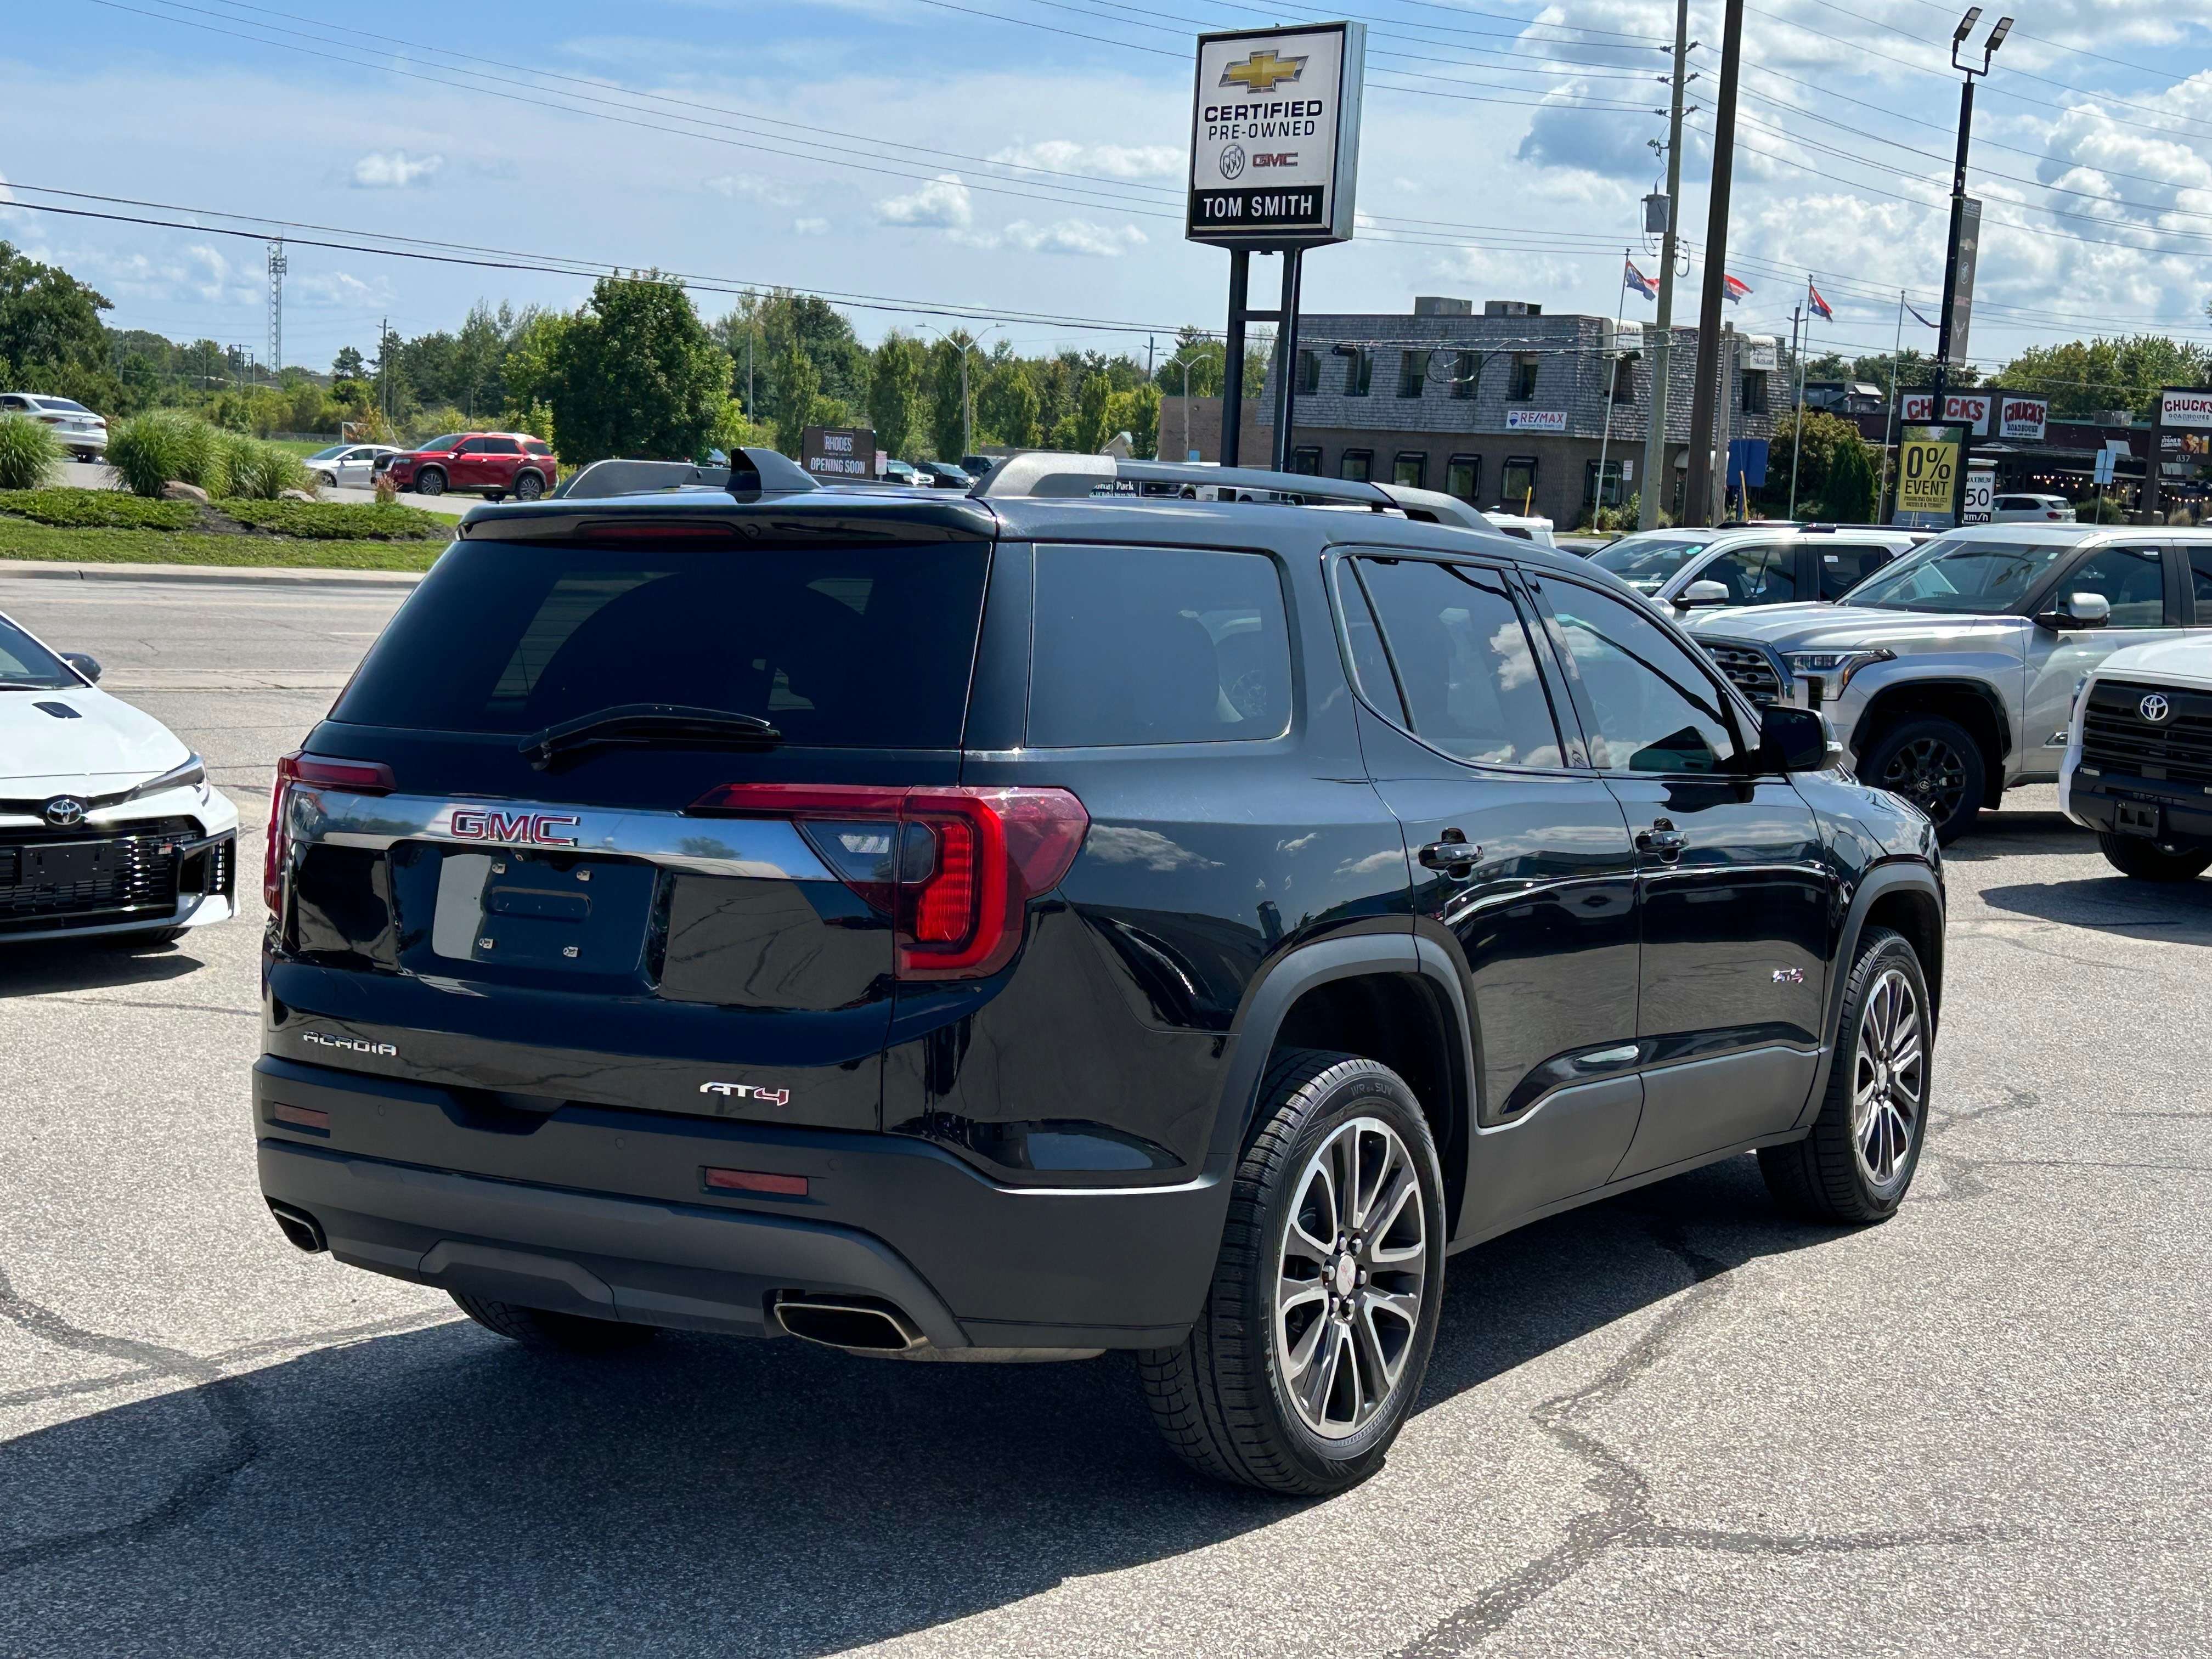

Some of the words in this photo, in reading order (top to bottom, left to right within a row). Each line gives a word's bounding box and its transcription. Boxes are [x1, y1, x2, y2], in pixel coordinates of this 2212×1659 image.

[1204, 100, 1323, 122] CERTIFIED
[1209, 120, 1315, 140] PRE-OWNED
[1252, 152, 1298, 167] GMC
[1203, 197, 1242, 217] TOM
[1251, 195, 1312, 216] SMITH
[1520, 412, 1564, 424] RE/MAX
[1907, 398, 1985, 421] CHCK'S
[825, 436, 852, 452] RHODES
[811, 457, 844, 473] OPENING
[845, 460, 866, 475] SOON
[1906, 446, 1951, 479] 0%
[1116, 481, 1134, 490] Park
[1905, 479, 1949, 496] EVENT
[1965, 488, 1989, 506] 50
[451, 809, 580, 847] GMC
[1772, 968, 1804, 983] AT4
[303, 1031, 397, 1056] ACADIA
[699, 1081, 790, 1106] AT4
[1375, 1082, 1392, 1096] SUV
